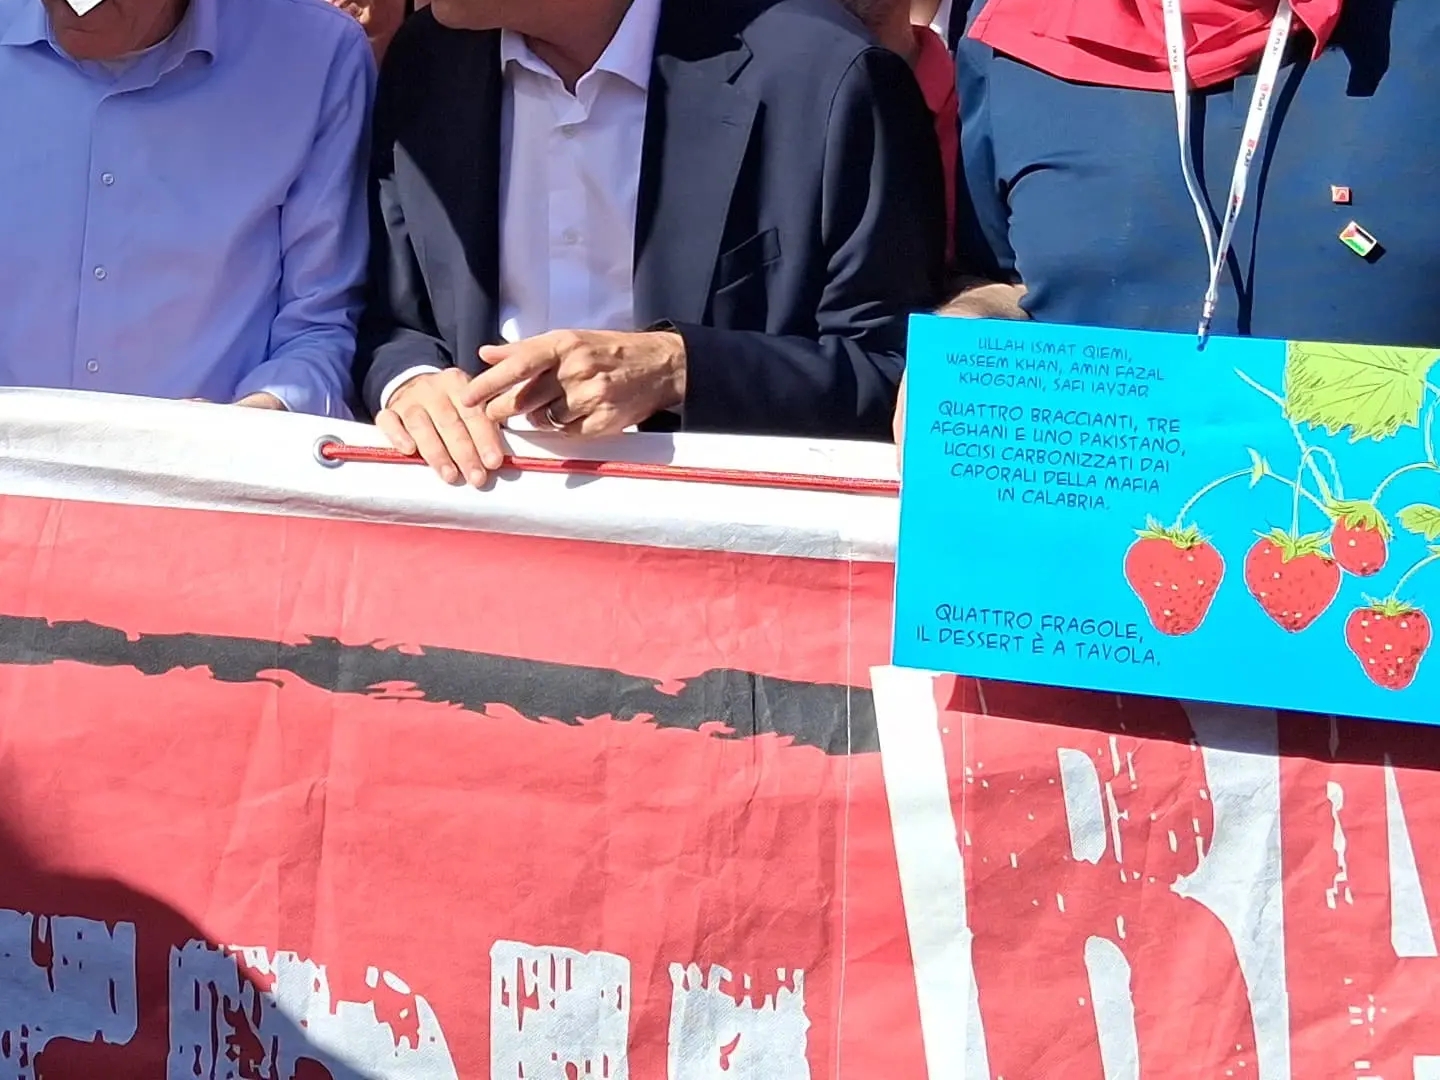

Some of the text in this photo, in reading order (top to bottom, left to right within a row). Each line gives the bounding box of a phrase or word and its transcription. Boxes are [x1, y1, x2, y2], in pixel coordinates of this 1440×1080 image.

[978, 337, 1024, 352] ULLAH
[1031, 339, 1076, 356] ISMAT
[946, 352, 1164, 381] WASEEM KHAN, AMIN FAZAL
[959, 372, 1047, 392] KHOGJANI,
[1053, 377, 1085, 392] SAFI
[938, 400, 1181, 433] QUATTRO BRACCIANTI, TRE
[930, 420, 1186, 457] AFGHANI E UNO PAKISTANO,
[944, 441, 1169, 473] UCCISI CARBONIZZATI DAI
[951, 463, 1160, 493] CAPORALI DELLA MAFIA
[998, 487, 1110, 511] IN CALABRIA.
[935, 603, 1144, 644] QUATTRO FRAGOLE,
[916, 625, 1161, 666] IL DESSERT È A TAVOLA.
